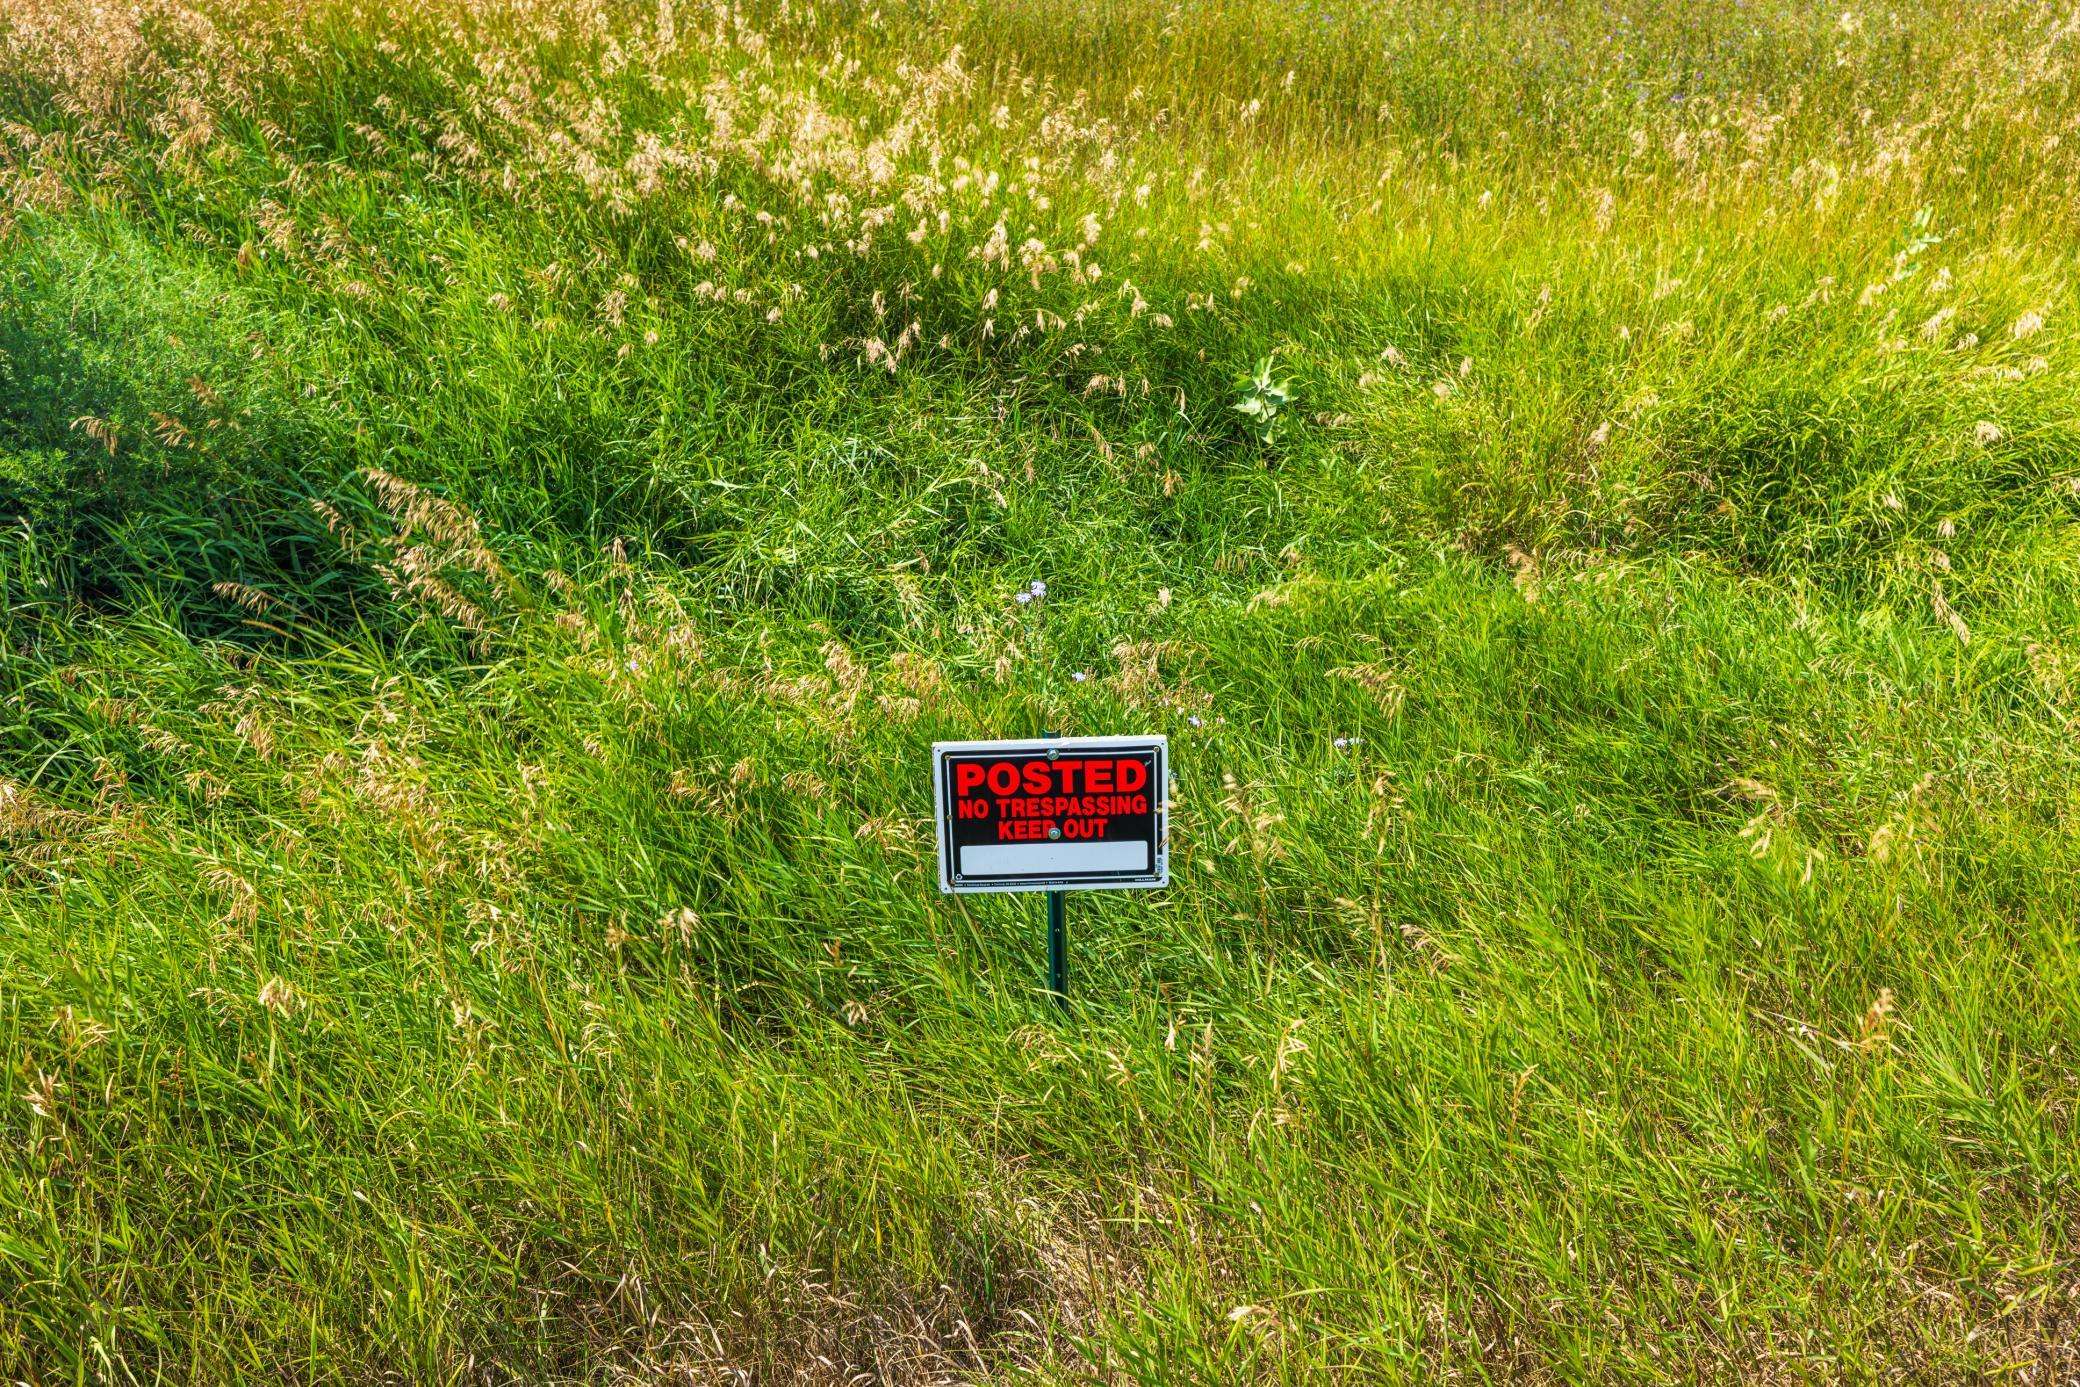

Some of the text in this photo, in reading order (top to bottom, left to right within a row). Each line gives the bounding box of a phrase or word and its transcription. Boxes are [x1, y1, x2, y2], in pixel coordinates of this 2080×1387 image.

[956, 759, 1147, 797] POSTED
[958, 795, 1148, 820] NO TRESPASSING
[998, 818, 1109, 841] KEEP OUT
